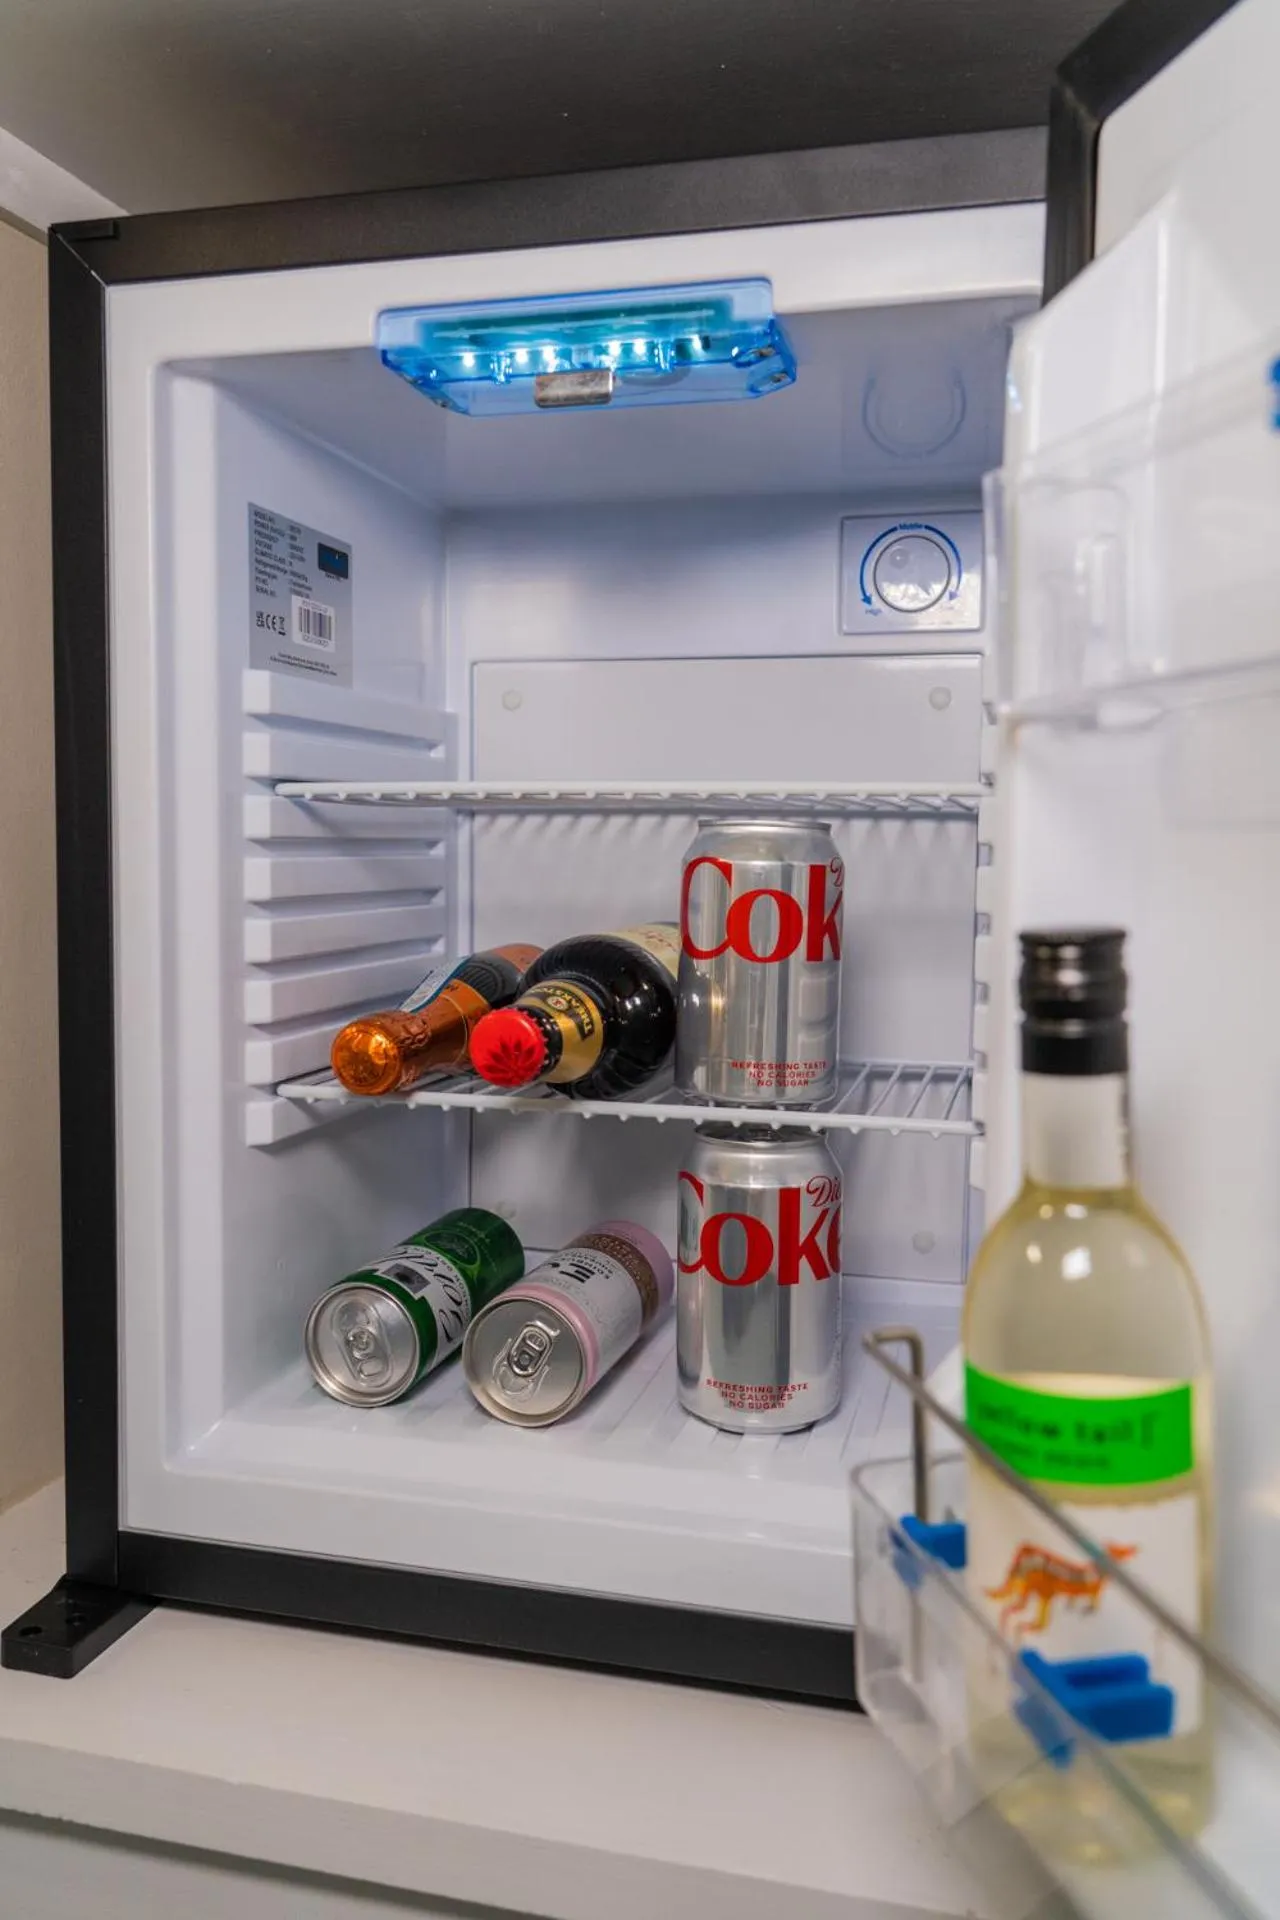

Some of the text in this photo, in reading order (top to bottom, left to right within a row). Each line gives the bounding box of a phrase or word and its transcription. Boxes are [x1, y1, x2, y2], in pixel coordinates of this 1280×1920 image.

[680, 857, 843, 963] Cok
[731, 1061, 799, 1070] REFRESHING
[749, 1070, 816, 1079] NO CALORIES
[777, 1079, 809, 1087] SUGAR
[706, 1378, 808, 1393] REFRESHING TASTE
[721, 1390, 793, 1402] NO CALORIES
[729, 1401, 785, 1410] NO SUGAR
